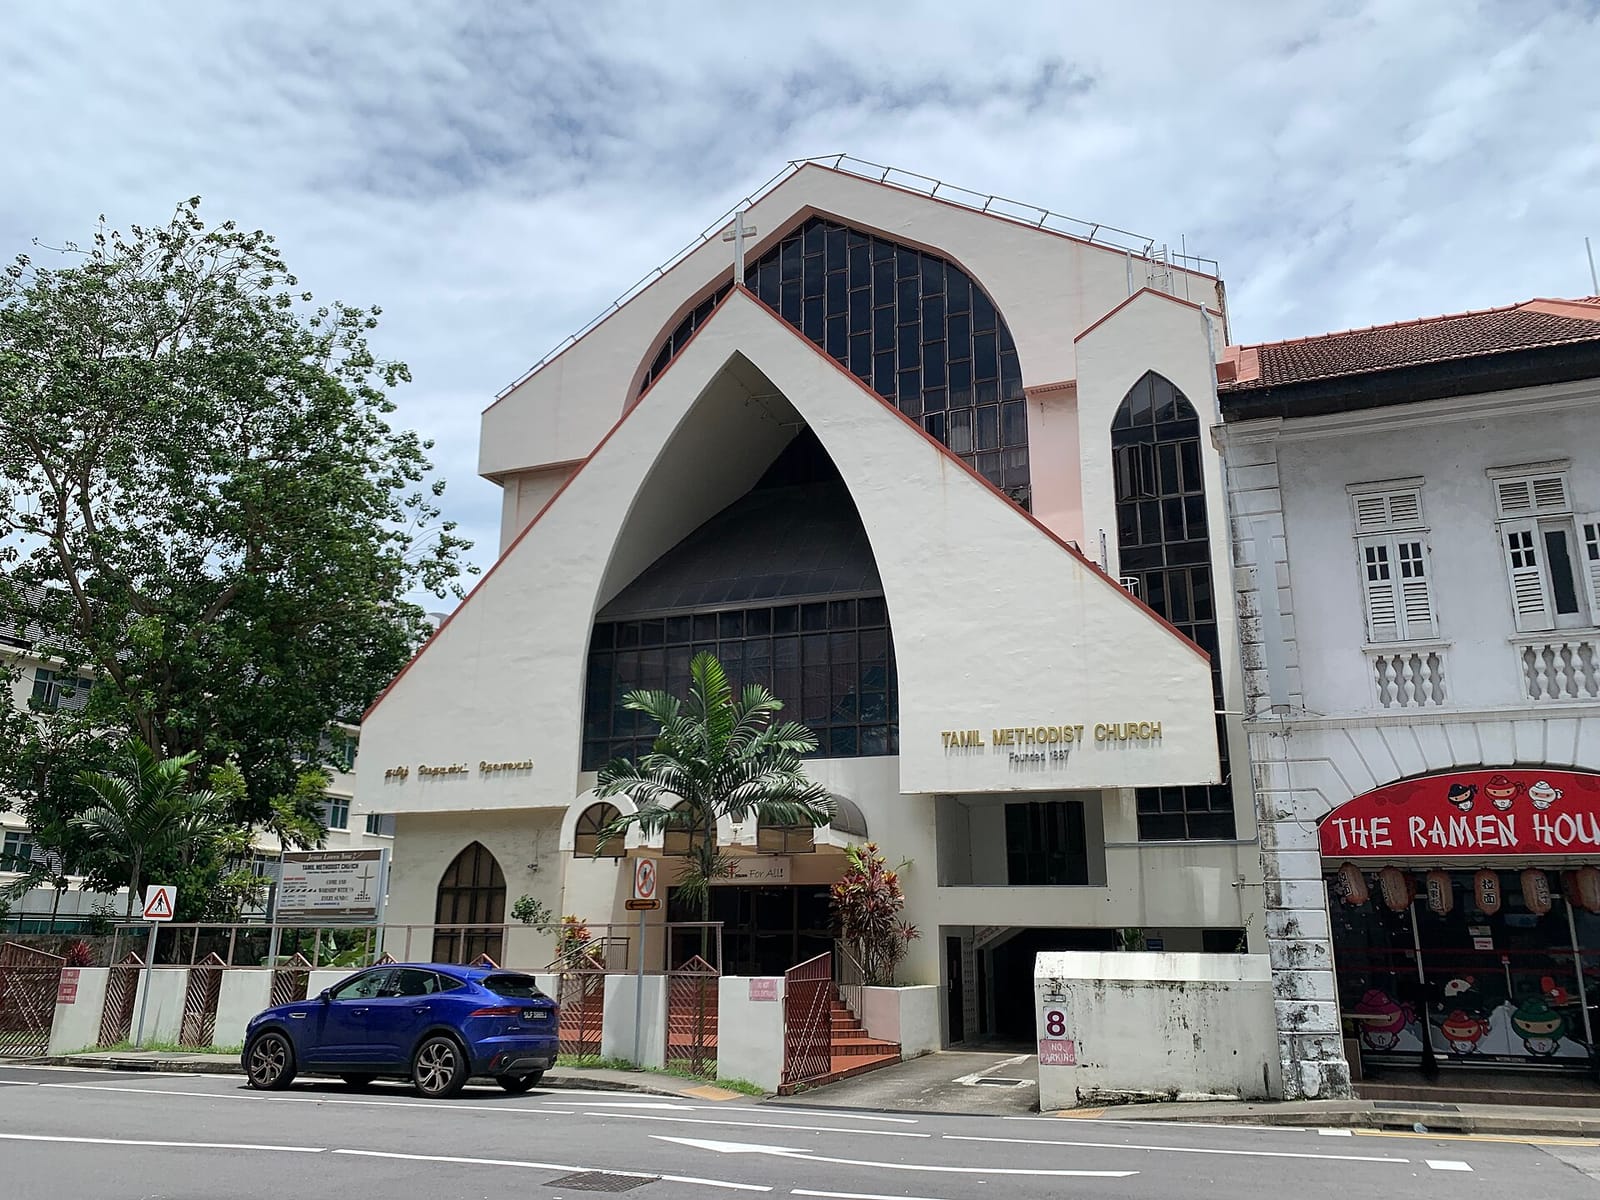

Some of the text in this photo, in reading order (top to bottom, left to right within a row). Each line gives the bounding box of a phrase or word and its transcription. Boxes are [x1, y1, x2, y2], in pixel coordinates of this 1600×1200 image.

[942, 721, 1163, 748] TAMIL METHODIST CHURCH
[1008, 750, 1070, 763] Founded 1887
[1332, 816, 1393, 849] THE
[1408, 814, 1519, 848] RAMEN
[1047, 1010, 1066, 1037] 8
[1051, 1043, 1063, 1051] NO
[1041, 1053, 1075, 1062] PARKING
